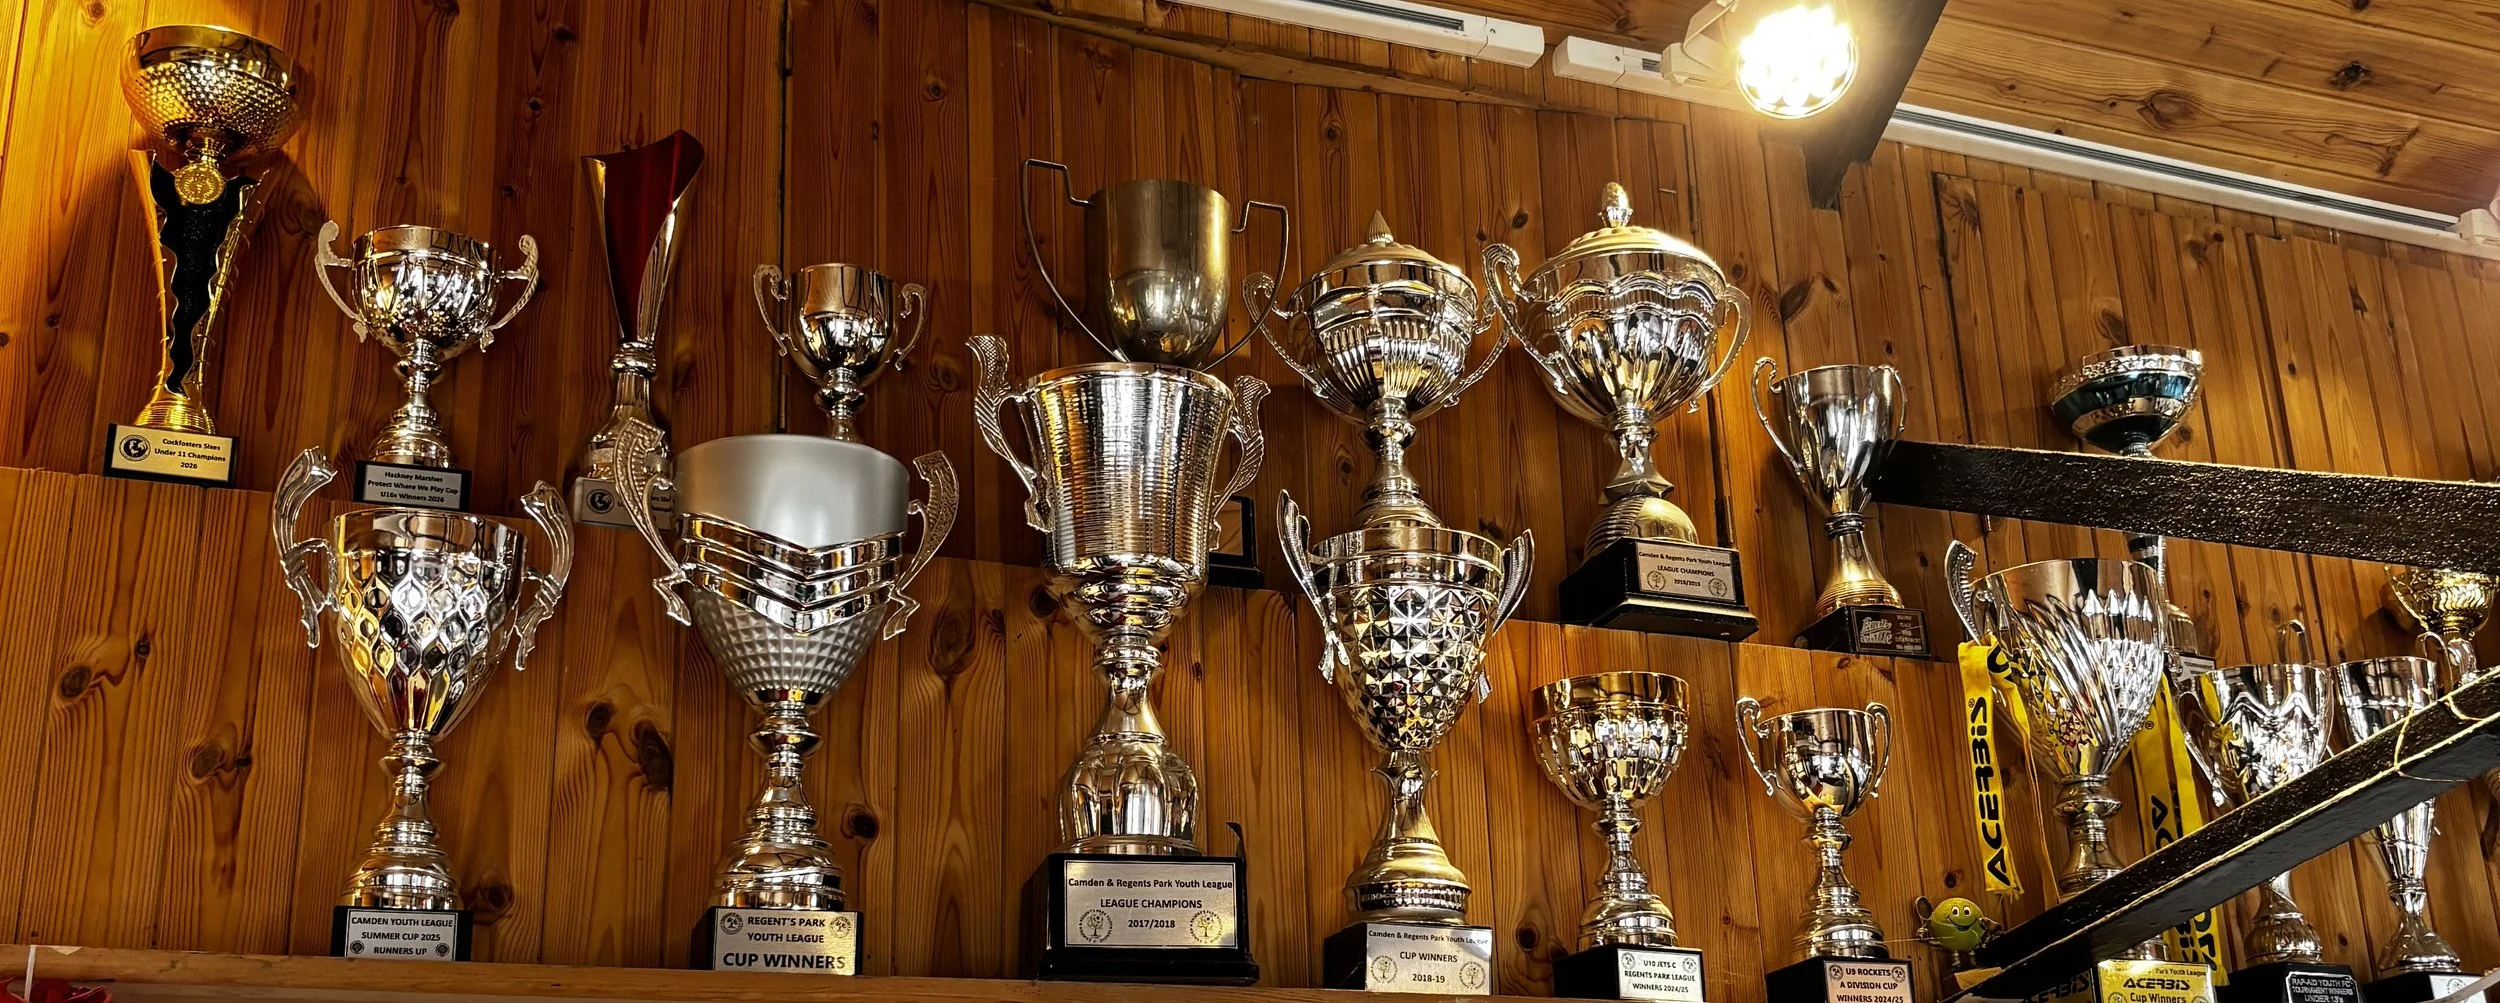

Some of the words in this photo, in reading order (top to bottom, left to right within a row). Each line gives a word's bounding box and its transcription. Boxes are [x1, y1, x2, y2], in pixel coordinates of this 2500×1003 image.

[162, 438, 202, 449] Cockfosters
[203, 443, 221, 451] Sixes
[154, 448, 176, 457] Under
[187, 452, 226, 462] Champions
[385, 471, 414, 480] Hackney
[415, 473, 443, 482] Marshes
[368, 480, 392, 488] Protect
[394, 482, 416, 490] Where
[430, 485, 444, 493] Play
[445, 487, 458, 495] Cup
[398, 493, 427, 501] Winners
[1665, 554, 1685, 562] Regents
[1657, 565, 1679, 573] LEAGUE
[1680, 568, 1715, 577] CHAMPIONS
[1068, 878, 1104, 887] Camden
[1106, 879, 1114, 887] &
[1116, 879, 1151, 889] Regents
[1153, 879, 1173, 888] Park
[1174, 879, 1200, 888] Youth
[1202, 880, 1233, 891] League
[1100, 899, 1139, 908] LEAGUE
[1141, 899, 1203, 909] CHAMPIONS
[351, 917, 389, 926] CAMDEN
[390, 918, 420, 927] YOUTH
[421, 919, 453, 928] LEAGUE
[747, 917, 797, 926] REGENT'S
[799, 918, 826, 927] PARK
[1128, 919, 1176, 930] 2017/2018
[361, 931, 400, 940] SUMMER
[402, 933, 419, 941] CUP
[421, 933, 441, 941] 2025
[747, 933, 783, 942] YOUTH
[786, 934, 825, 943] LEAGUE
[1368, 930, 1396, 939] Camden
[1403, 932, 1429, 942] Regents
[1430, 934, 1445, 942] Park
[1446, 935, 1465, 944] Youth
[374, 946, 414, 955] RUNNERS
[722, 952, 759, 967] CUP
[763, 954, 846, 969] WINNERS
[1399, 951, 1417, 960] CUP
[1418, 953, 1458, 963] WINNERS
[1624, 970, 1653, 979] REGENTS
[1654, 972, 1670, 980] PARK
[1671, 974, 1696, 982] LEAGUE
[1845, 967, 1856, 975] U9
[1857, 968, 1891, 977] ROCKETS
[1412, 973, 1445, 983] 2018-19
[1632, 983, 1663, 991] WINNERS
[1663, 985, 1689, 993] 2024/25
[1847, 981, 1881, 990] DIVISION
[1883, 982, 1898, 990] CUP
[1836, 994, 1872, 1003] WINNERS
[1874, 995, 1904, 1003] 2024/25
[2130, 992, 2147, 1003] Cup
[2148, 993, 2187, 1003] Winners
[2304, 995, 2330, 1003] UNDER
